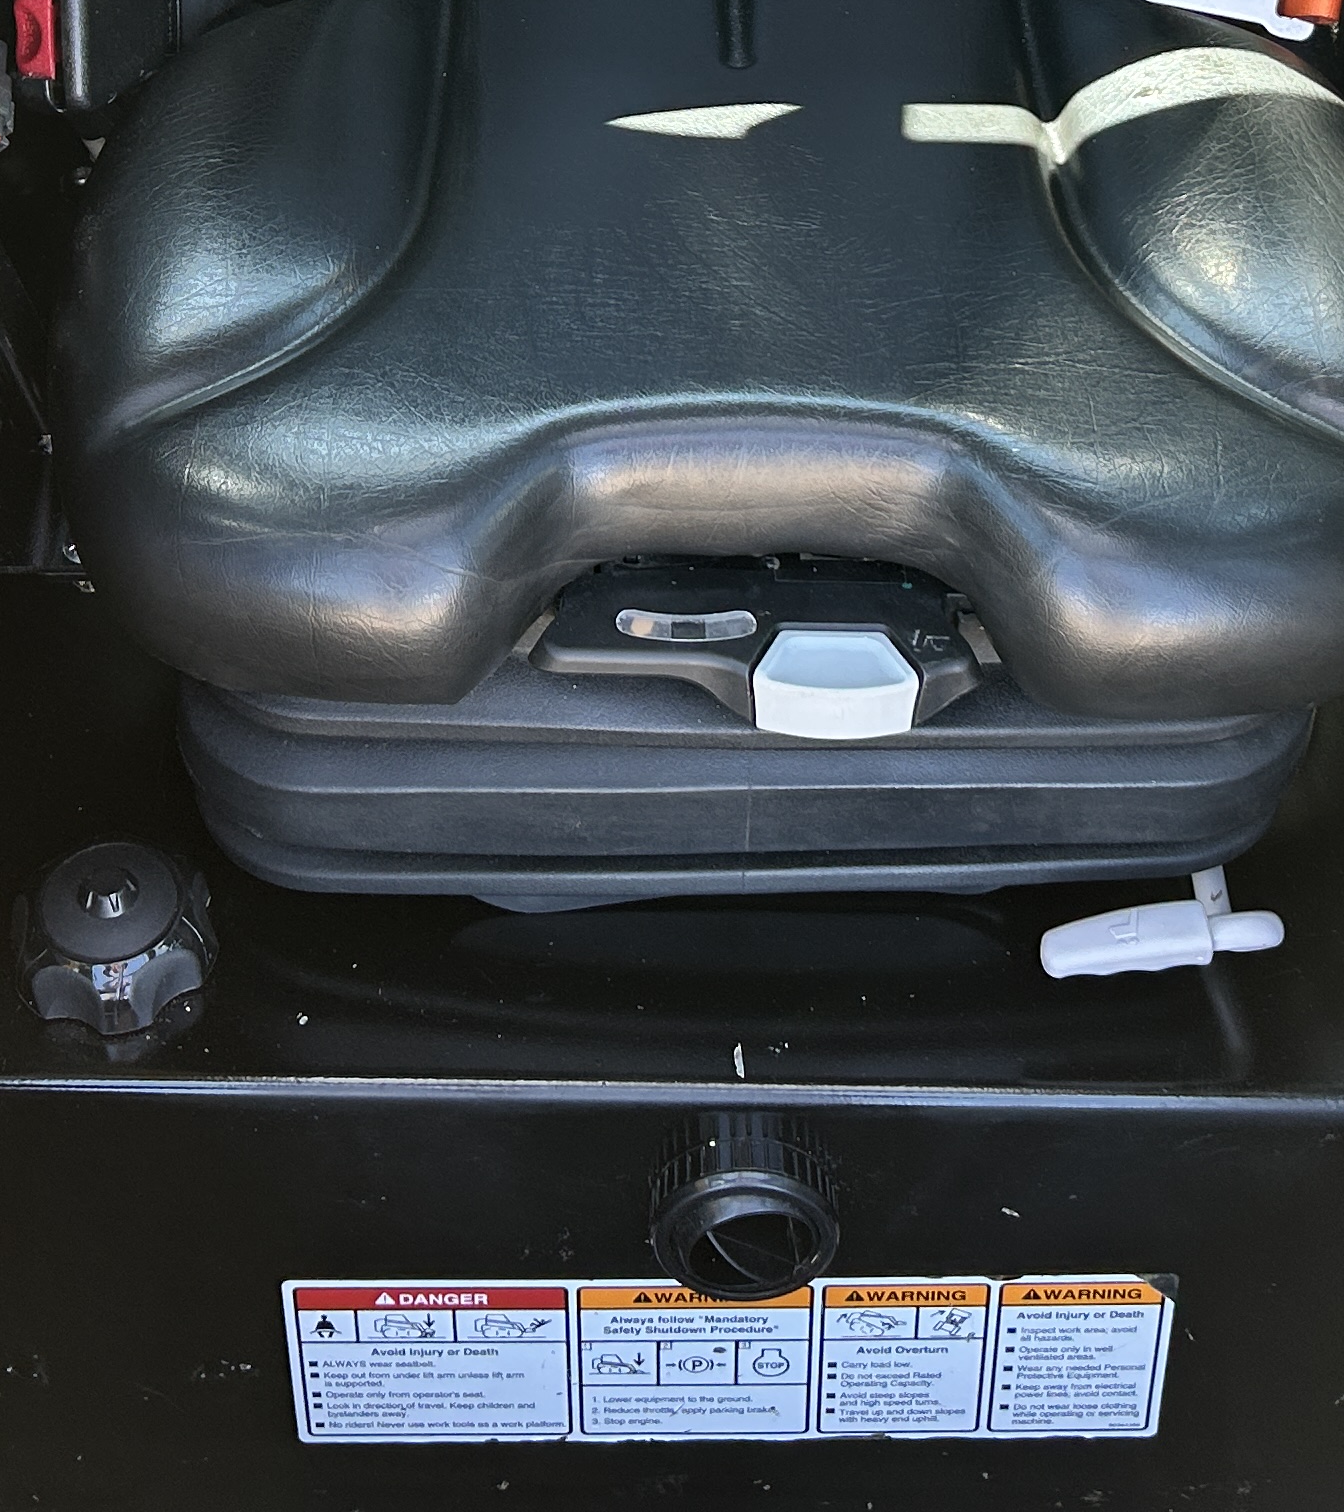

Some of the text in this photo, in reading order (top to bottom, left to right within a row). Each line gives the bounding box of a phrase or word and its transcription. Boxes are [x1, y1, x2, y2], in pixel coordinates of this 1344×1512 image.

[399, 1293, 489, 1306] DANGER
[654, 1292, 730, 1304] WARN
[866, 1290, 967, 1302] WARNING
[1043, 1288, 1142, 1300] WARNING
[610, 1316, 654, 1325] Always
[658, 1315, 695, 1323] follow
[1016, 1311, 1052, 1320] Avoid
[1055, 1311, 1090, 1321] Injury
[1109, 1310, 1144, 1319] Death
[603, 1326, 642, 1336] Safety
[645, 1325, 706, 1334] Shutdown
[371, 1347, 406, 1356] Avoid
[409, 1347, 444, 1358] Injury
[463, 1347, 499, 1356] Death
[856, 1345, 949, 1354] Avoid Overturn
[757, 1361, 785, 1369] STOP
[323, 1372, 348, 1380] Keep
[368, 1371, 391, 1379] from
[392, 1371, 420, 1379] under
[422, 1371, 434, 1379] lift
[458, 1371, 489, 1379] unless
[491, 1371, 503, 1379] lift
